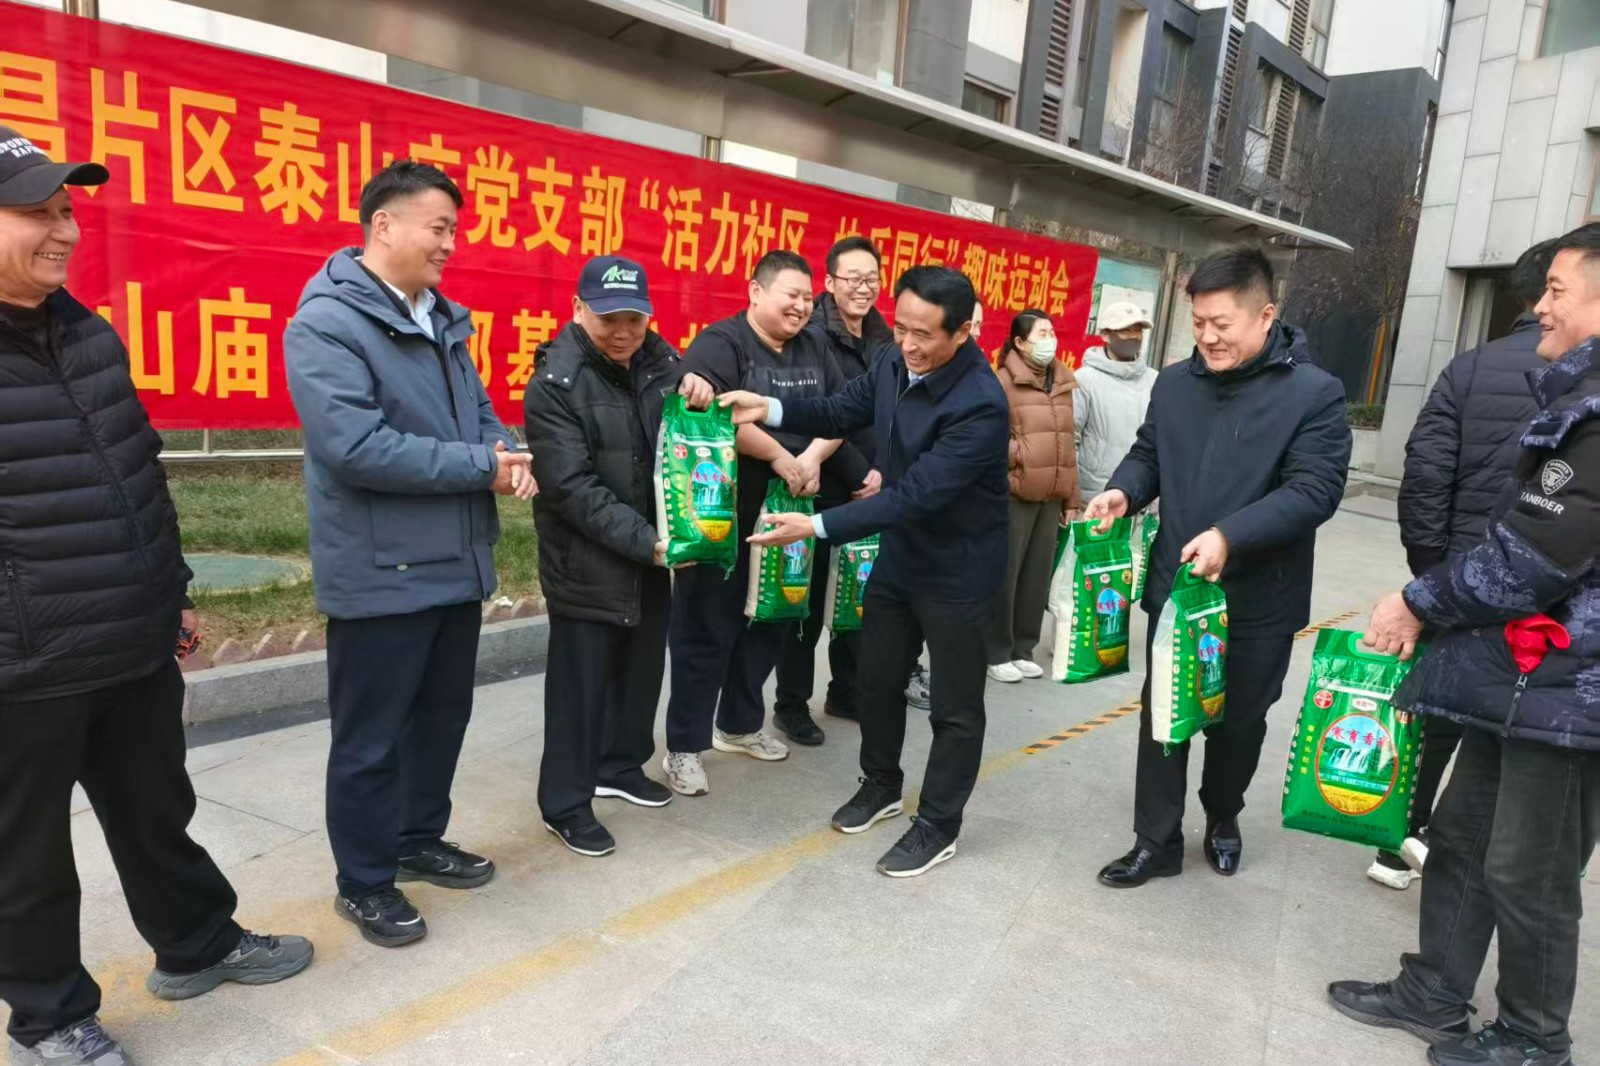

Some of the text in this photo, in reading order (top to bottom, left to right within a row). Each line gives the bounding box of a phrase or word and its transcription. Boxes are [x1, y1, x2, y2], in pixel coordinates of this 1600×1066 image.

[0, 51, 809, 280] 昌片区泰山党支部“活力社区
